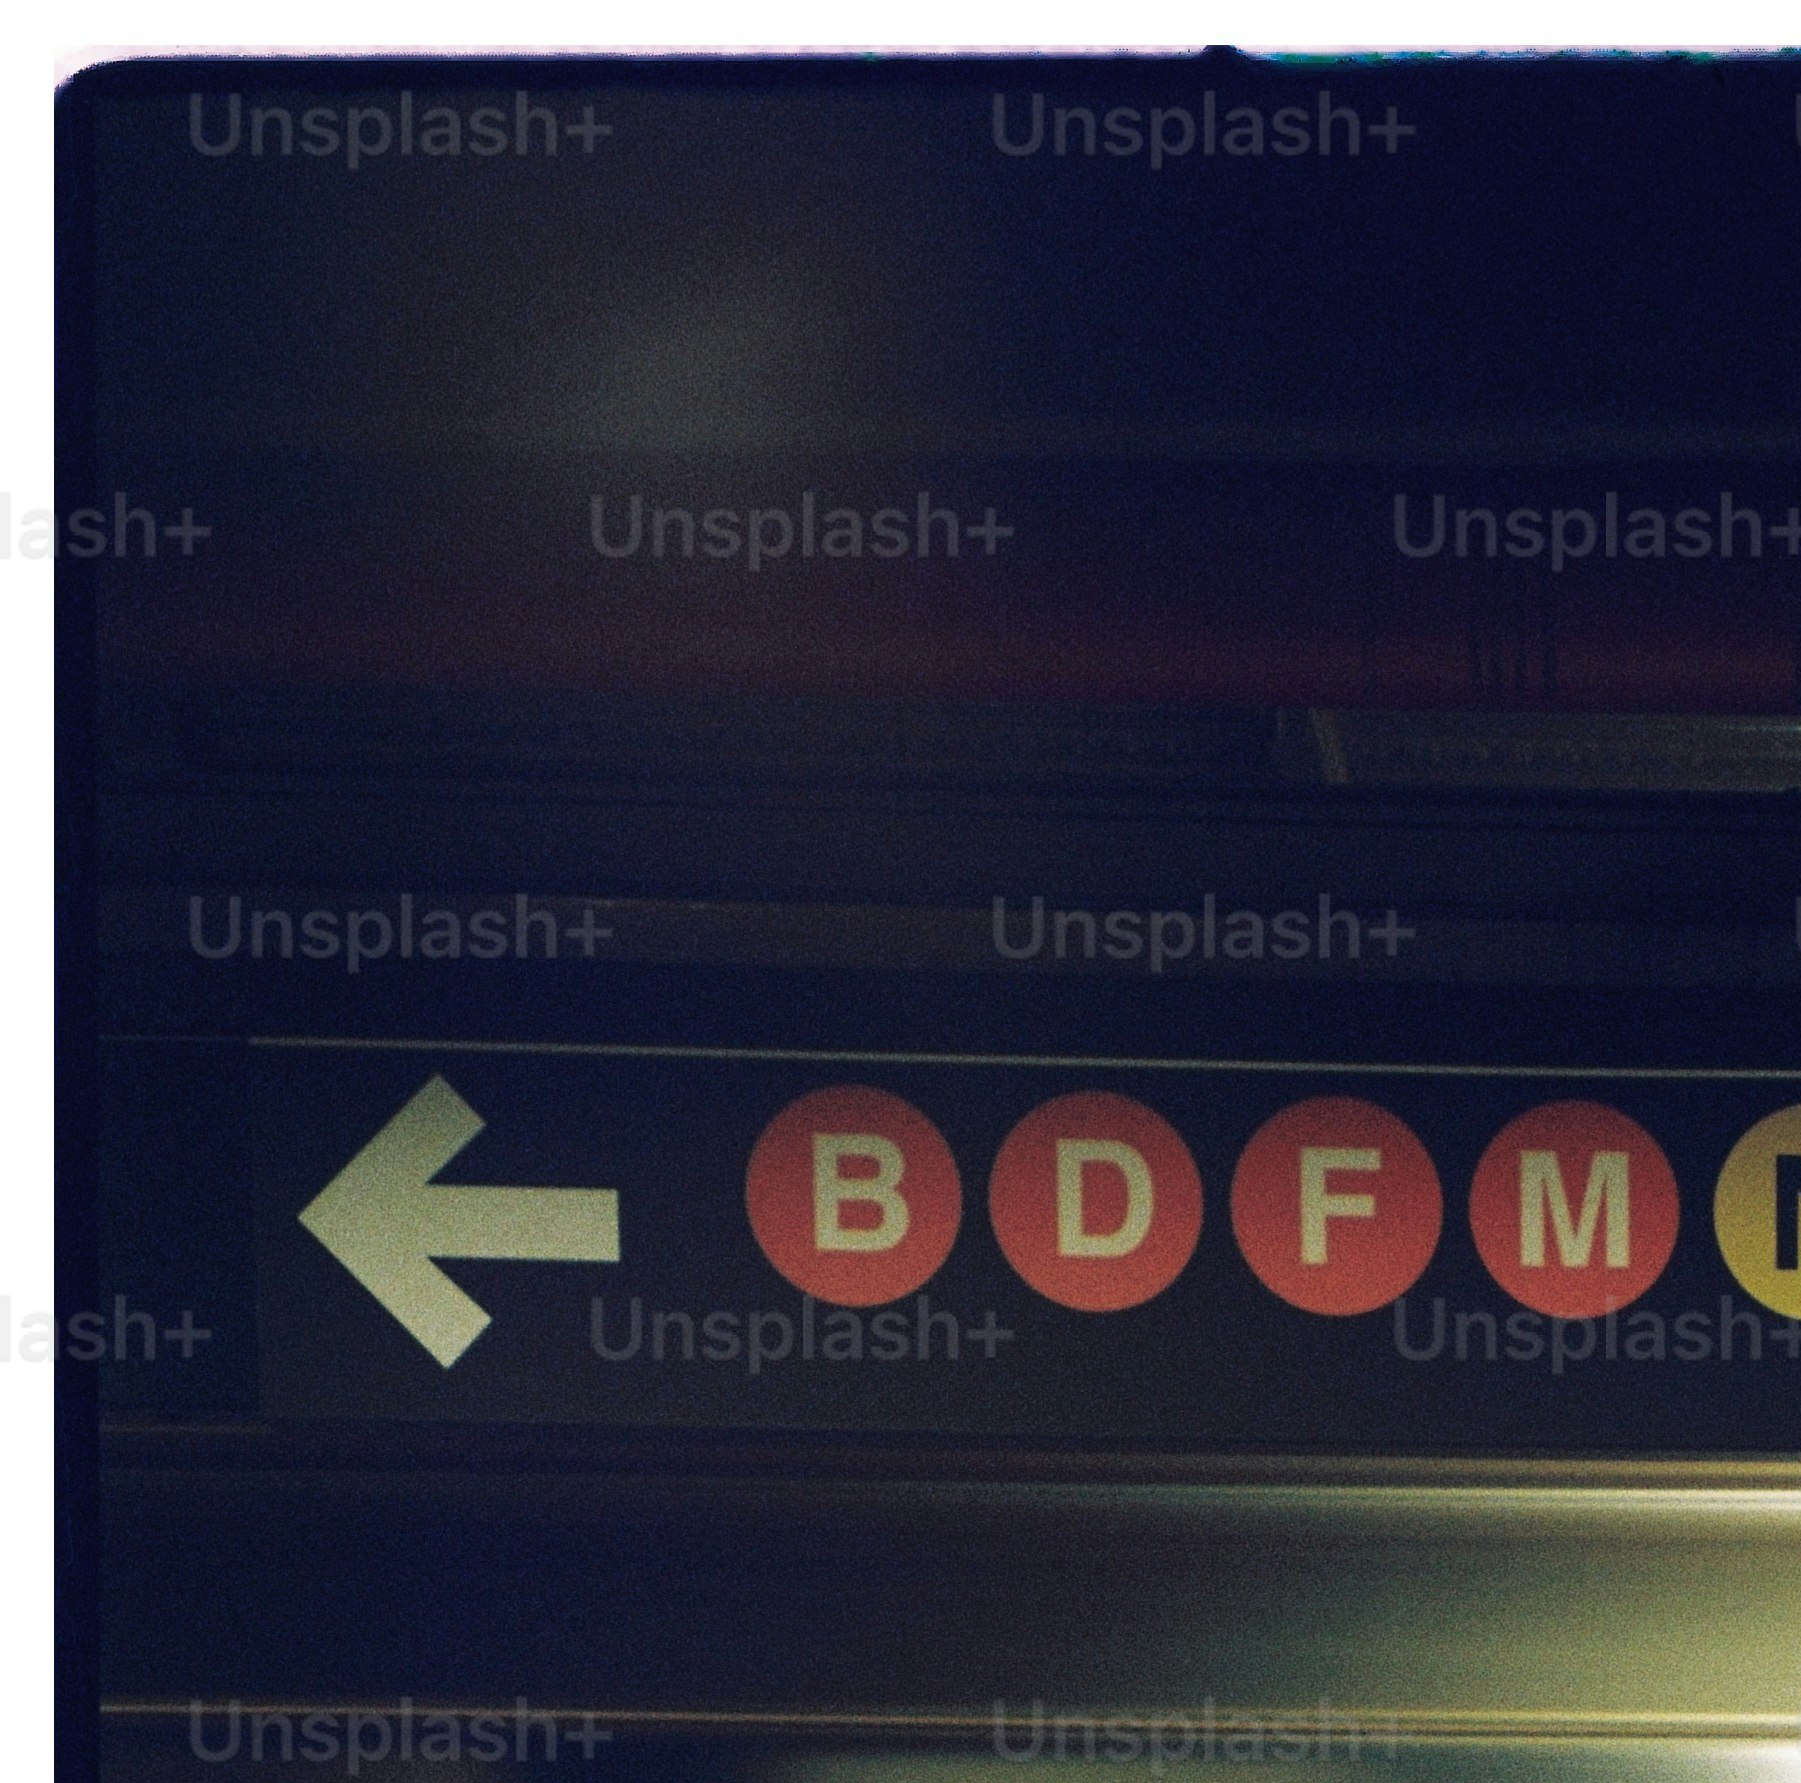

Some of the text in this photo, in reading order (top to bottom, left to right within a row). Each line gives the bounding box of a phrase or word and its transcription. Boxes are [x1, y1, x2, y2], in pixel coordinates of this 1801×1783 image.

[814, 1135, 910, 1254] B
[1057, 1140, 1154, 1259] D
[1300, 1148, 1382, 1266] F
[1519, 1151, 1631, 1269] M
